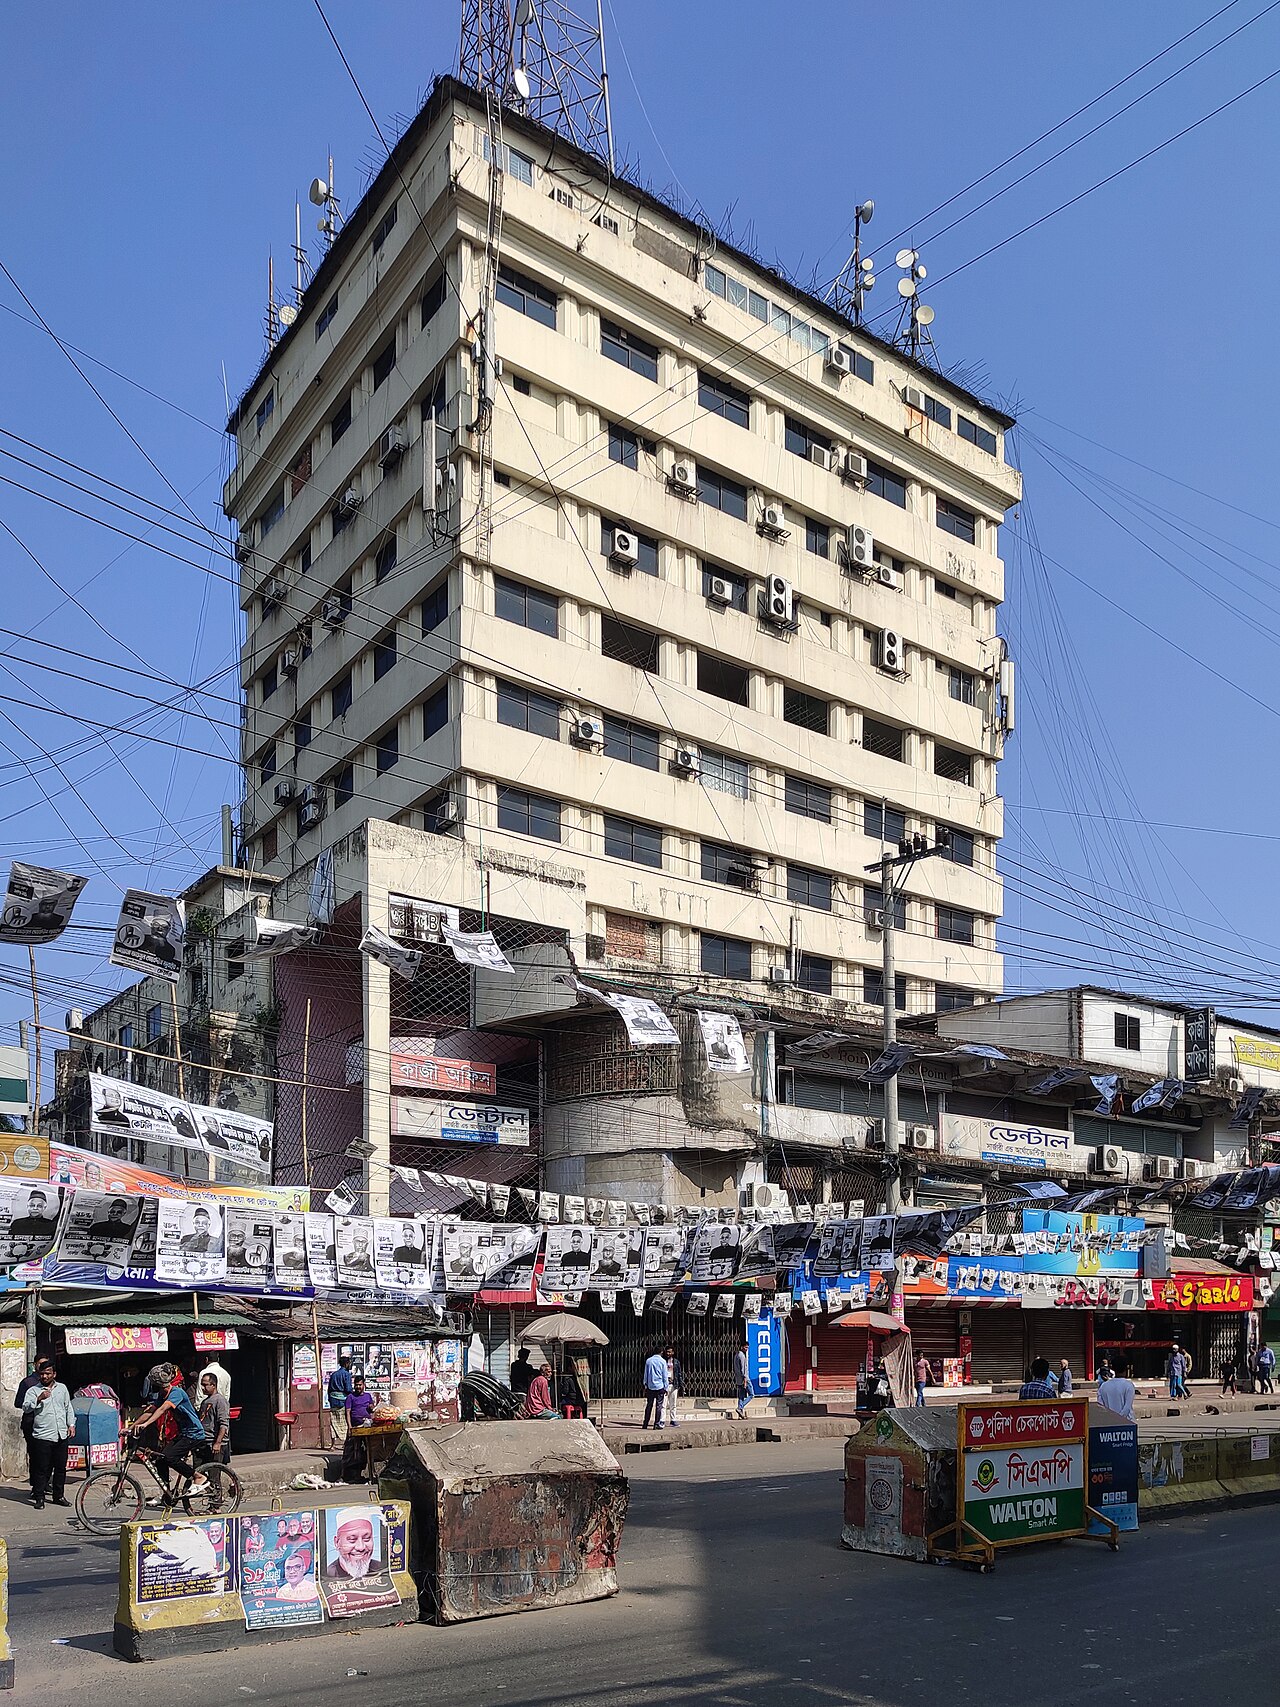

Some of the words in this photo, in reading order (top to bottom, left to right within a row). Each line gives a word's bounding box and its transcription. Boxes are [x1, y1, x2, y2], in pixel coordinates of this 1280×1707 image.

[399, 1060, 439, 1081] কাজী
[445, 1065, 491, 1086] অফিস
[922, 1068, 948, 1080] Point
[449, 1106, 526, 1125] ডেন্টাল
[990, 1127, 1069, 1149] ডেন্টাল
[125, 1267, 149, 1280] মো.
[1181, 1278, 1240, 1307] Sizzle
[757, 1315, 771, 1388] TECNO
[971, 1422, 983, 1431] STOP
[987, 1411, 1013, 1439] পুলিশ
[1016, 1408, 1060, 1433] চেকপোস্ট
[1099, 1430, 1134, 1443] WALTON
[1006, 1448, 1074, 1489] সিএমপি
[989, 1496, 1057, 1524] WALTON
[1028, 1519, 1047, 1529] Smart
[1048, 1517, 1058, 1525] AC
